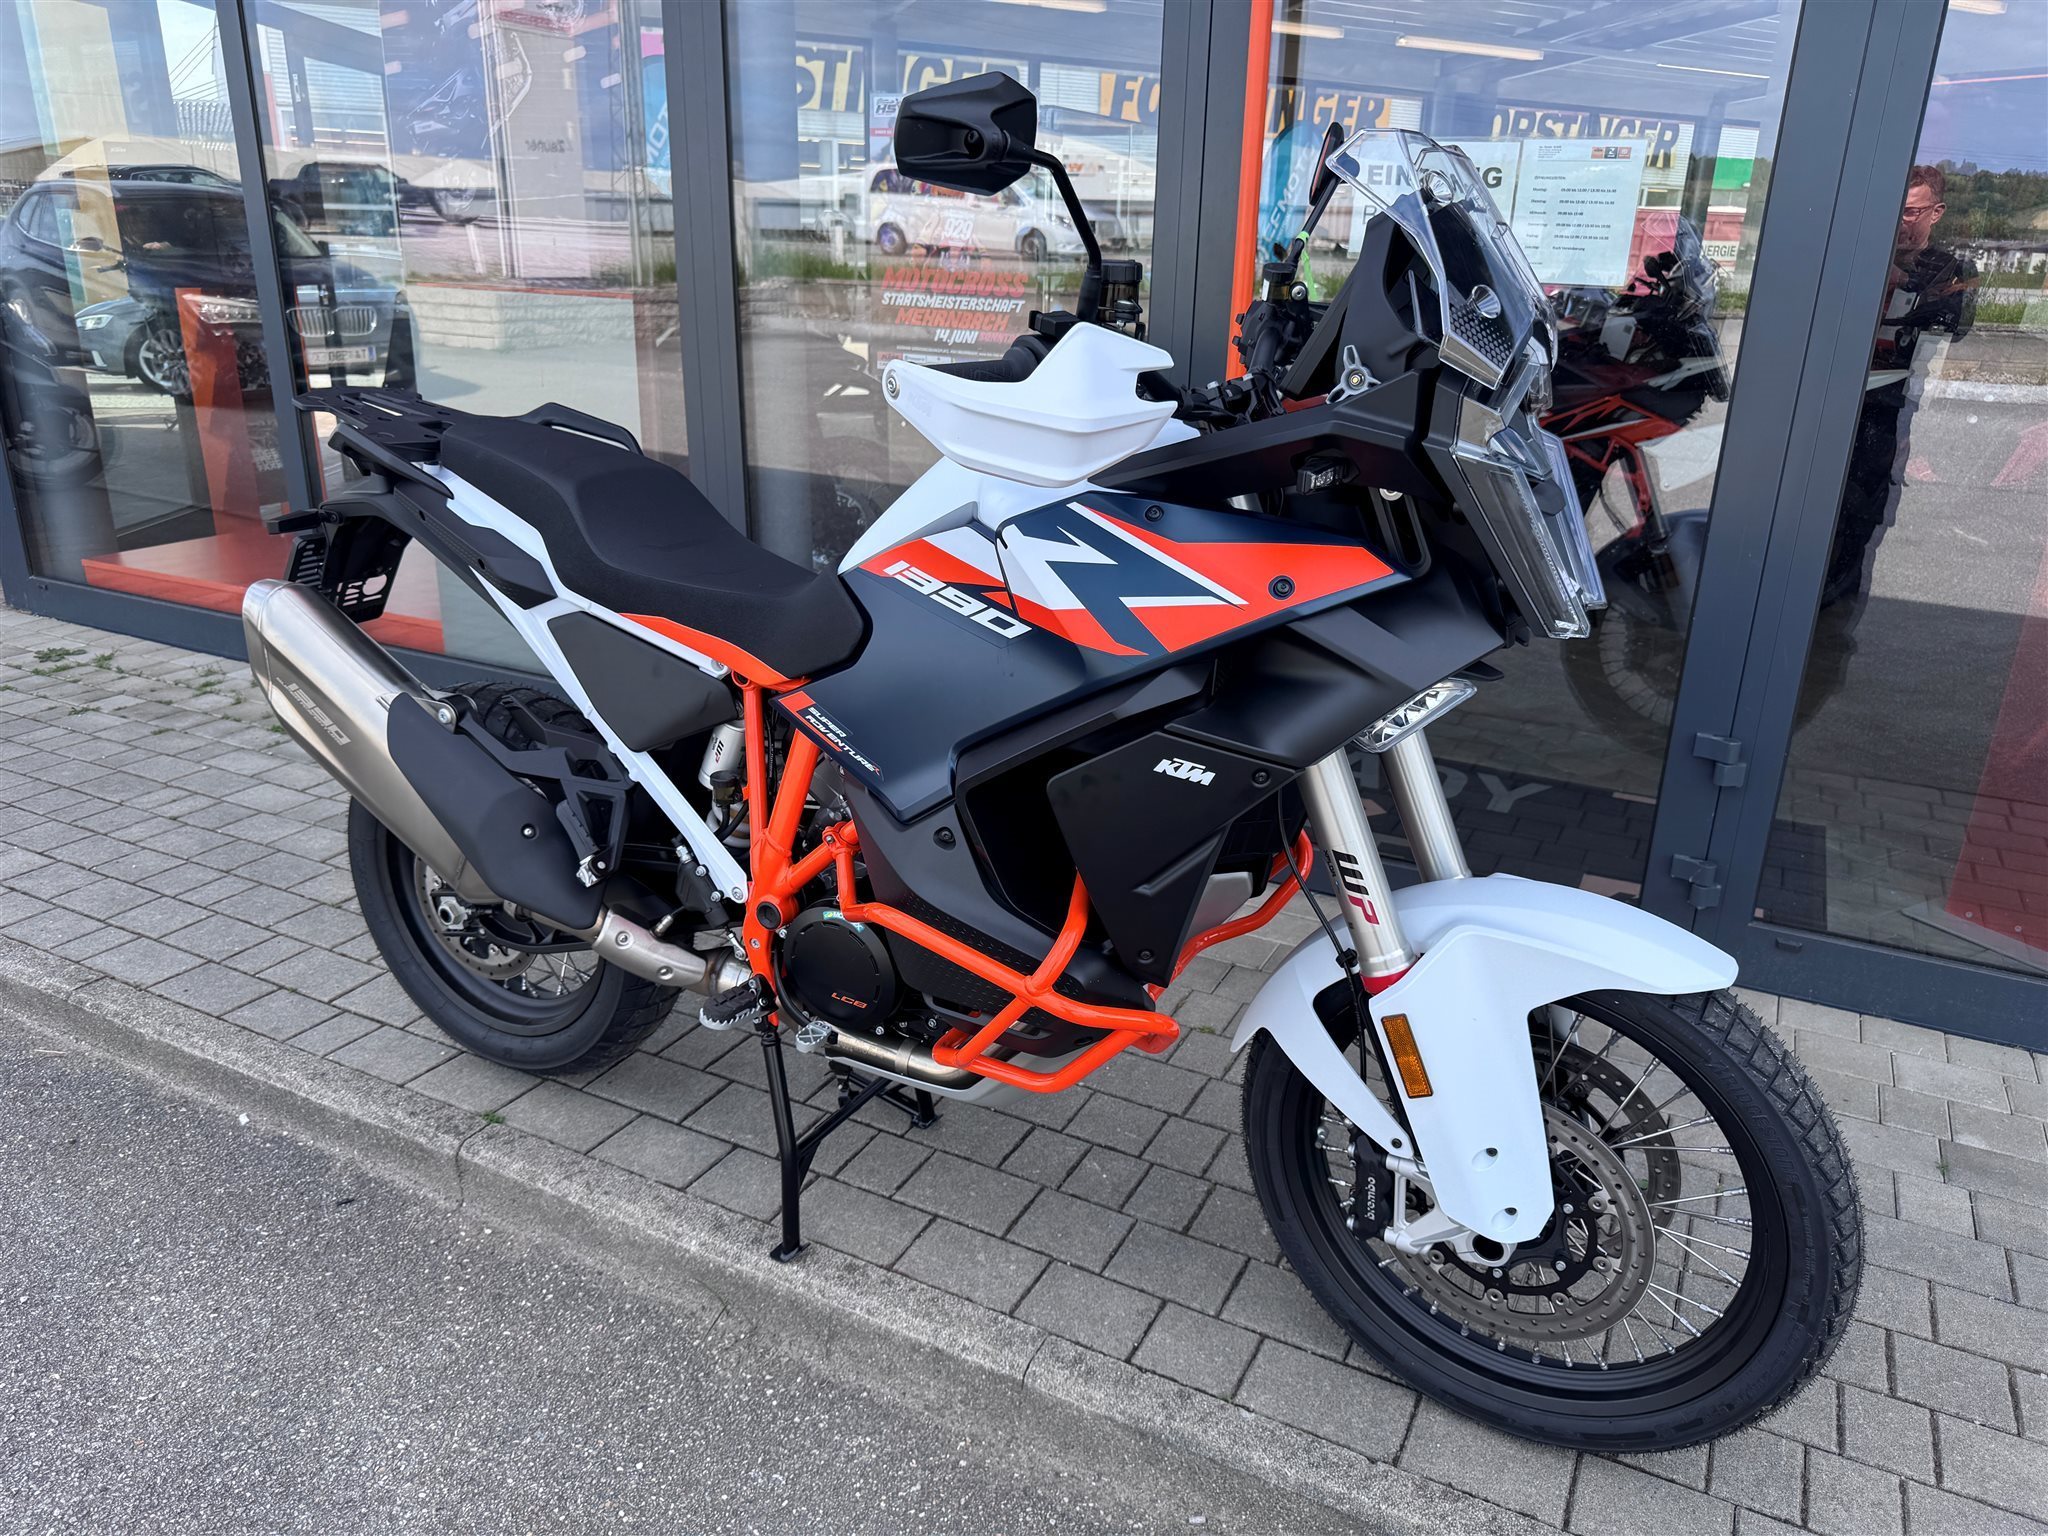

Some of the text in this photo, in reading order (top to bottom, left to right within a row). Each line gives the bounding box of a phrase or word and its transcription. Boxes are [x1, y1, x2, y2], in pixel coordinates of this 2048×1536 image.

[943, 219, 974, 241] 929
[881, 266, 1029, 298] MOTOCROSS
[881, 291, 1026, 314] STAATSMEISTERSCHAFT
[895, 307, 1011, 332] MEHRNBACH
[882, 559, 1033, 640] 1390
[807, 706, 848, 738] SUPER
[805, 714, 875, 773] ADVENTURE
[1152, 757, 1217, 787] KTM
[830, 991, 868, 1010] LC8
[1364, 1176, 1377, 1221] brembo
